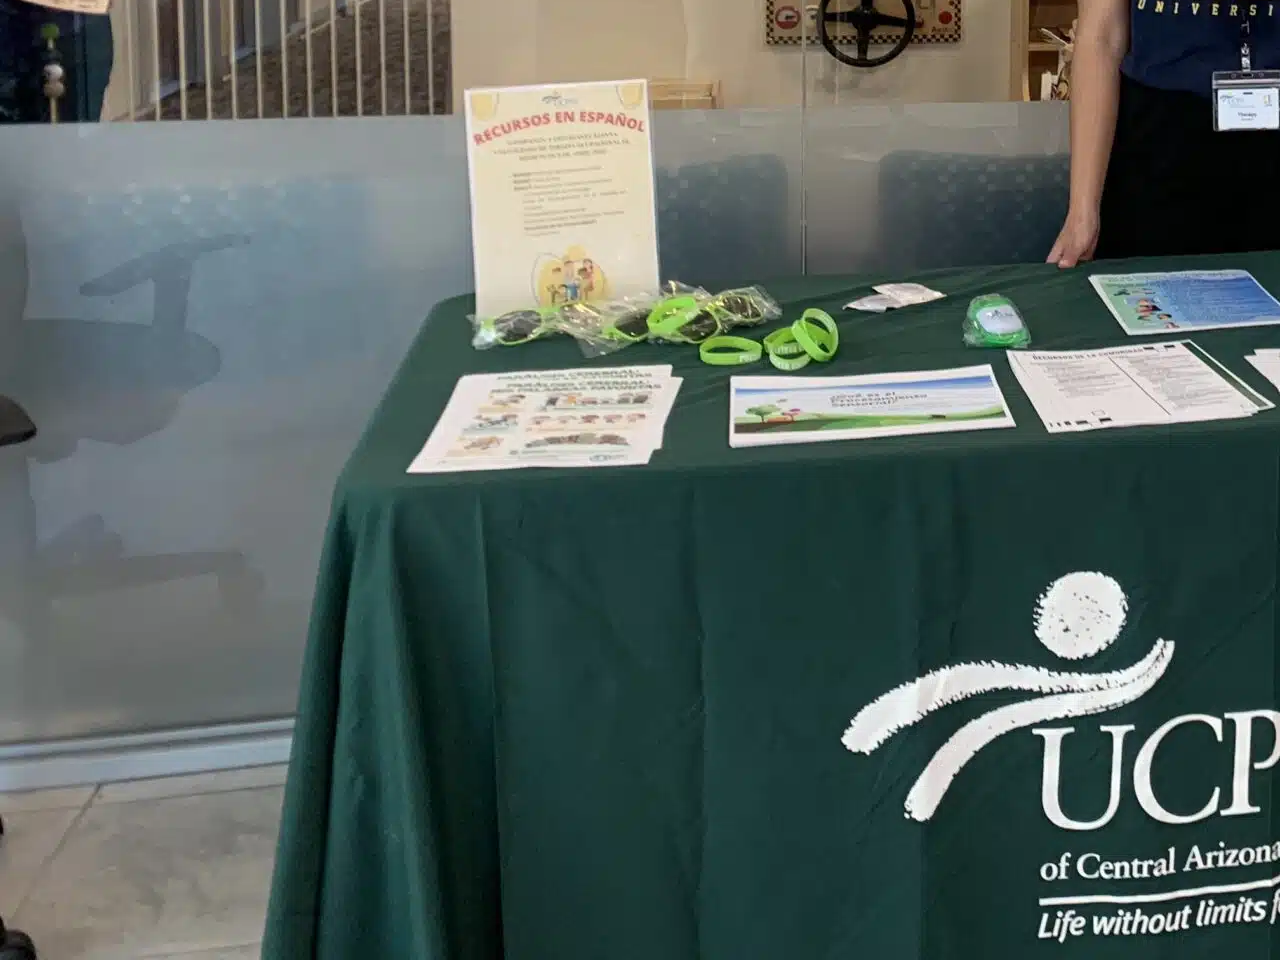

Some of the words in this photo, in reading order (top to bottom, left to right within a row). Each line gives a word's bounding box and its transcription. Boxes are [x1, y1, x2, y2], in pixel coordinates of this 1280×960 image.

[473, 112, 551, 145] RECURSOS
[555, 110, 575, 124] EN
[579, 110, 645, 133] ESPAÑOL
[1040, 852, 1072, 880] of
[1077, 846, 1176, 879] Central
[1037, 910, 1087, 944] Life
[1092, 904, 1192, 937] without
[1196, 897, 1268, 927] limits
